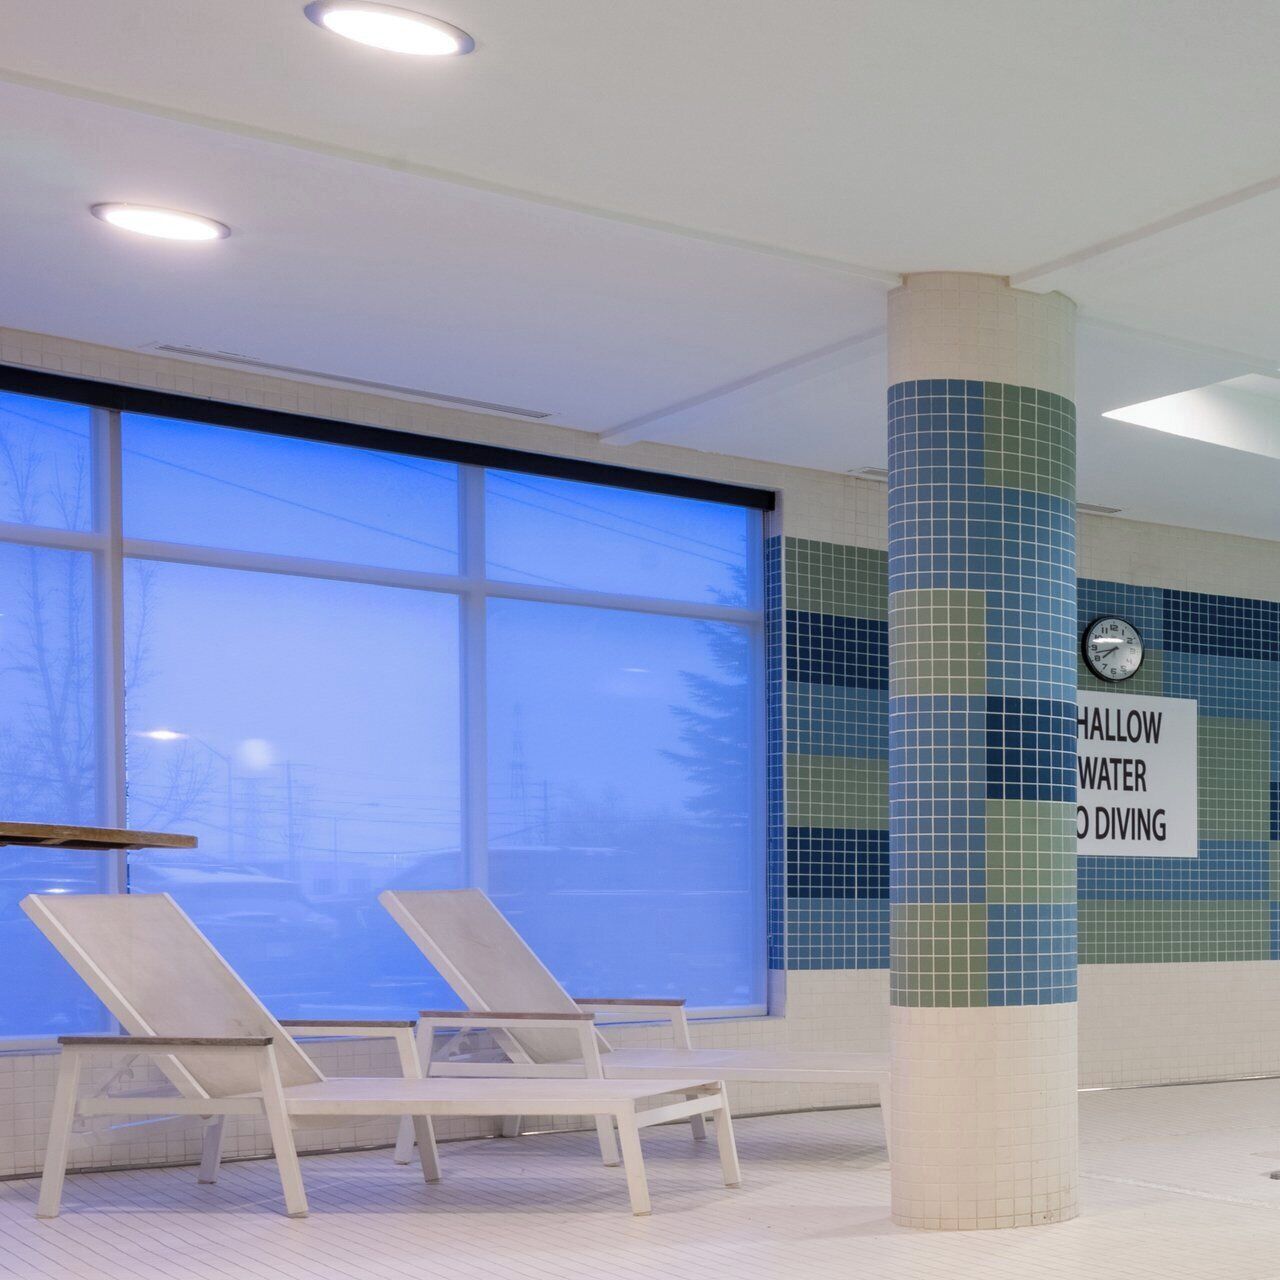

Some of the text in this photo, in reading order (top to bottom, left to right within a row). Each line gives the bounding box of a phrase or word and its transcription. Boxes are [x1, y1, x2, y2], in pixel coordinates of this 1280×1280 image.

[1077, 706, 1162, 744] HALLOW
[1078, 756, 1147, 792] WATER
[1077, 805, 1166, 841] O DIVING
